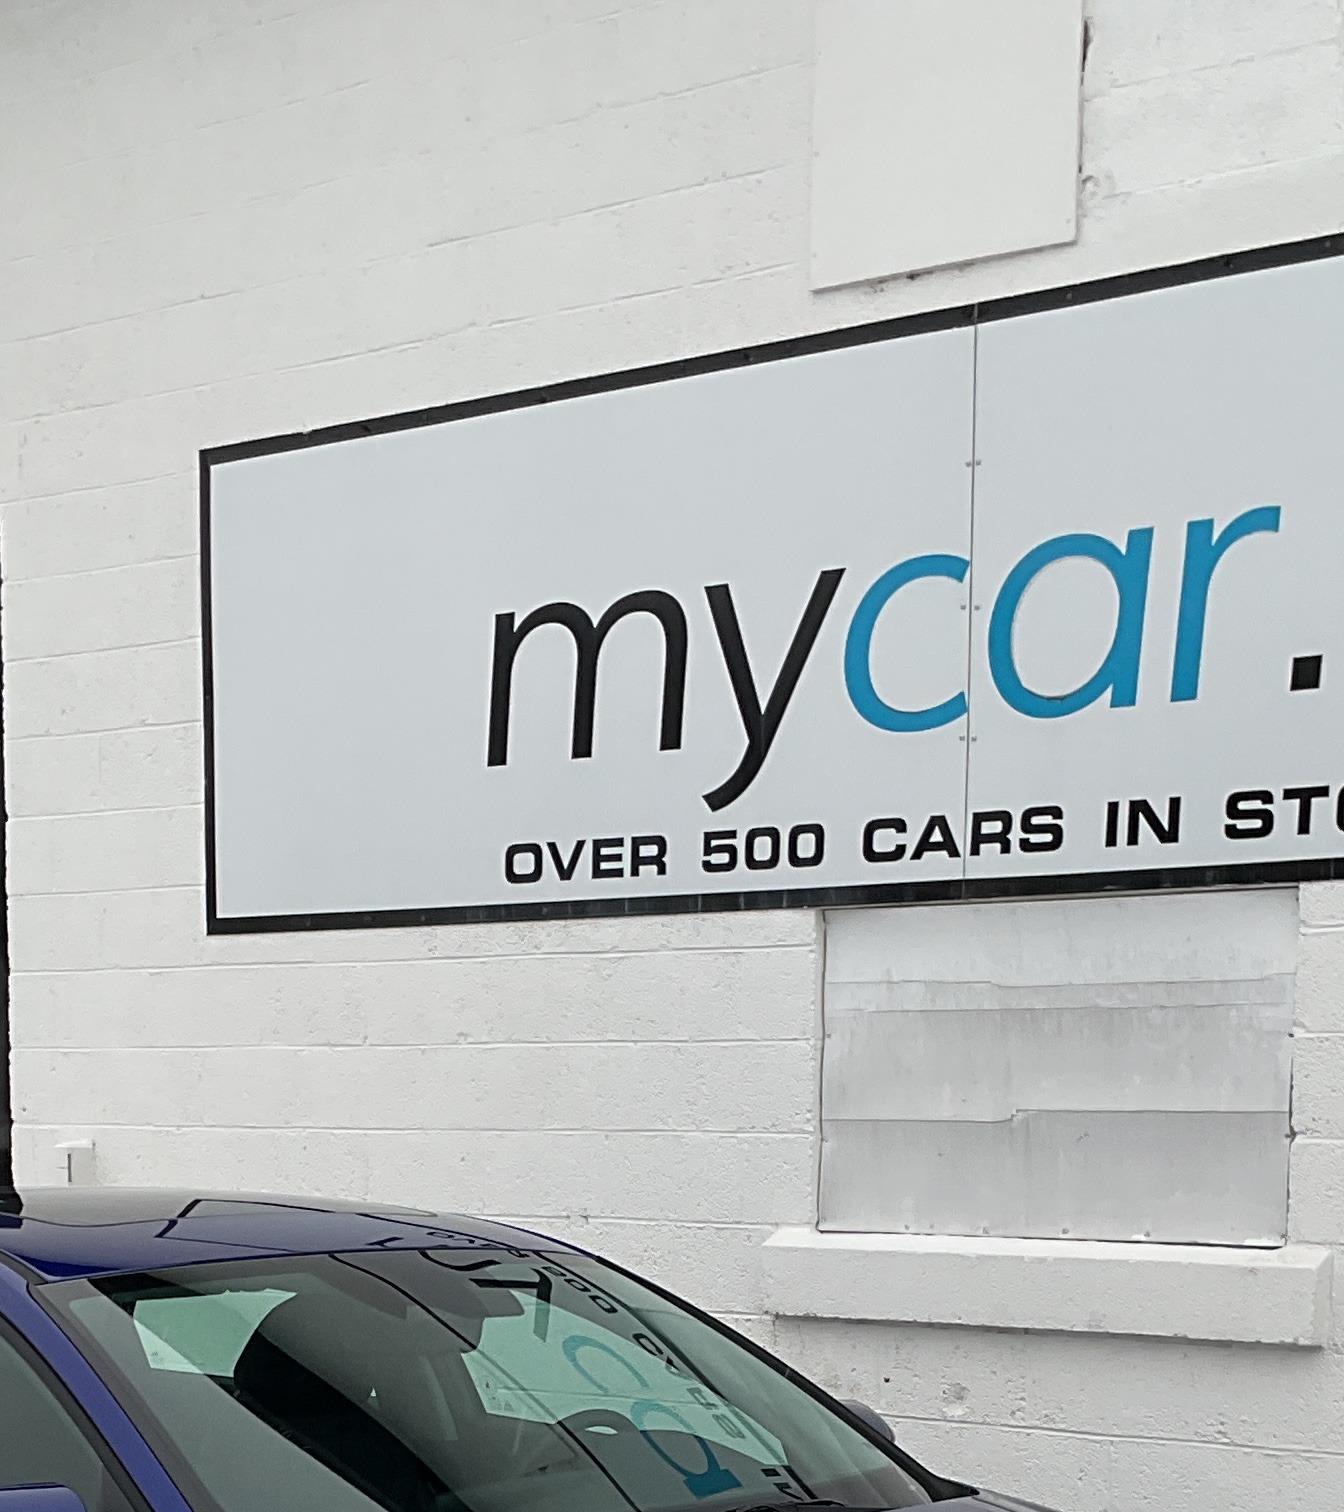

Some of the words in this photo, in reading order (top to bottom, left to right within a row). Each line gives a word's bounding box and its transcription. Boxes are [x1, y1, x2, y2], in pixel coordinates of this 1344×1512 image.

[504, 835, 668, 884] OVER
[701, 823, 826, 874] 500
[862, 805, 1064, 864] CARS
[1104, 796, 1182, 849] IN
